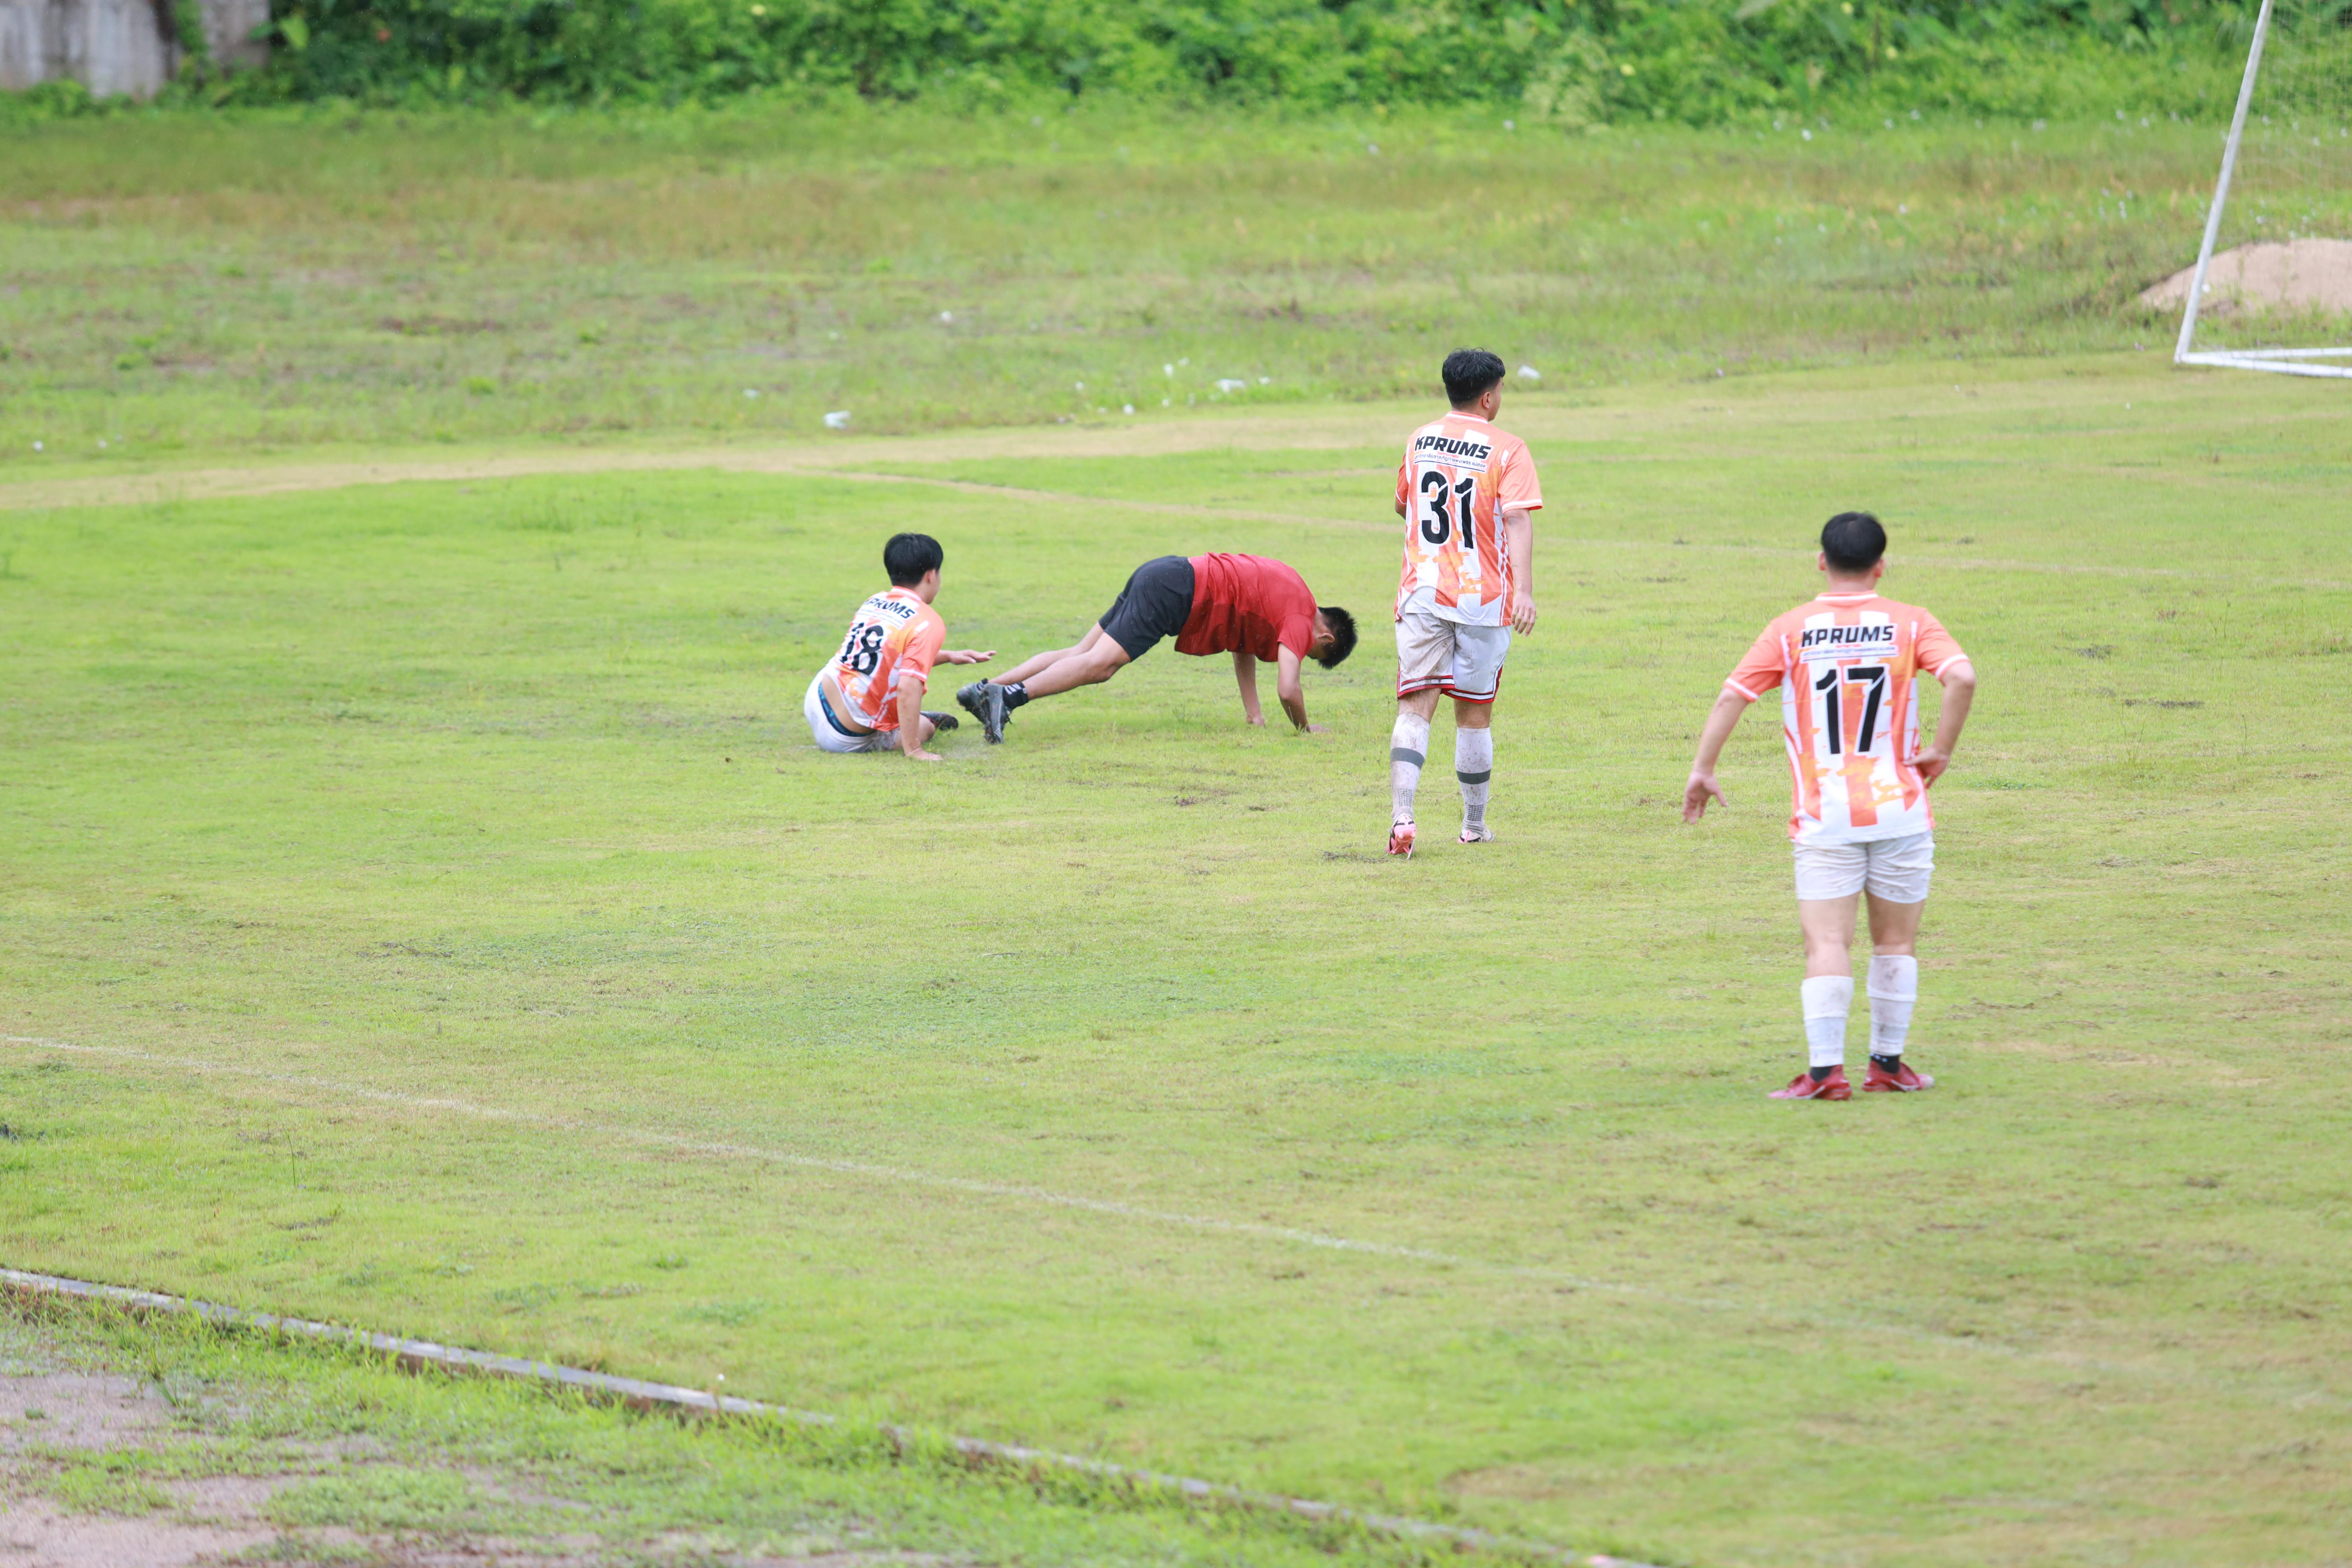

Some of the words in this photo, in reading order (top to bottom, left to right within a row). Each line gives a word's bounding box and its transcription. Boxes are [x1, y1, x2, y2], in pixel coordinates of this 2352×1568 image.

[1415, 436, 1491, 459] KPRUMS
[1421, 471, 1473, 549] 31
[841, 622, 883, 675] 18
[1802, 626, 1893, 647] KPRUMS
[1816, 667, 1885, 754] 17
